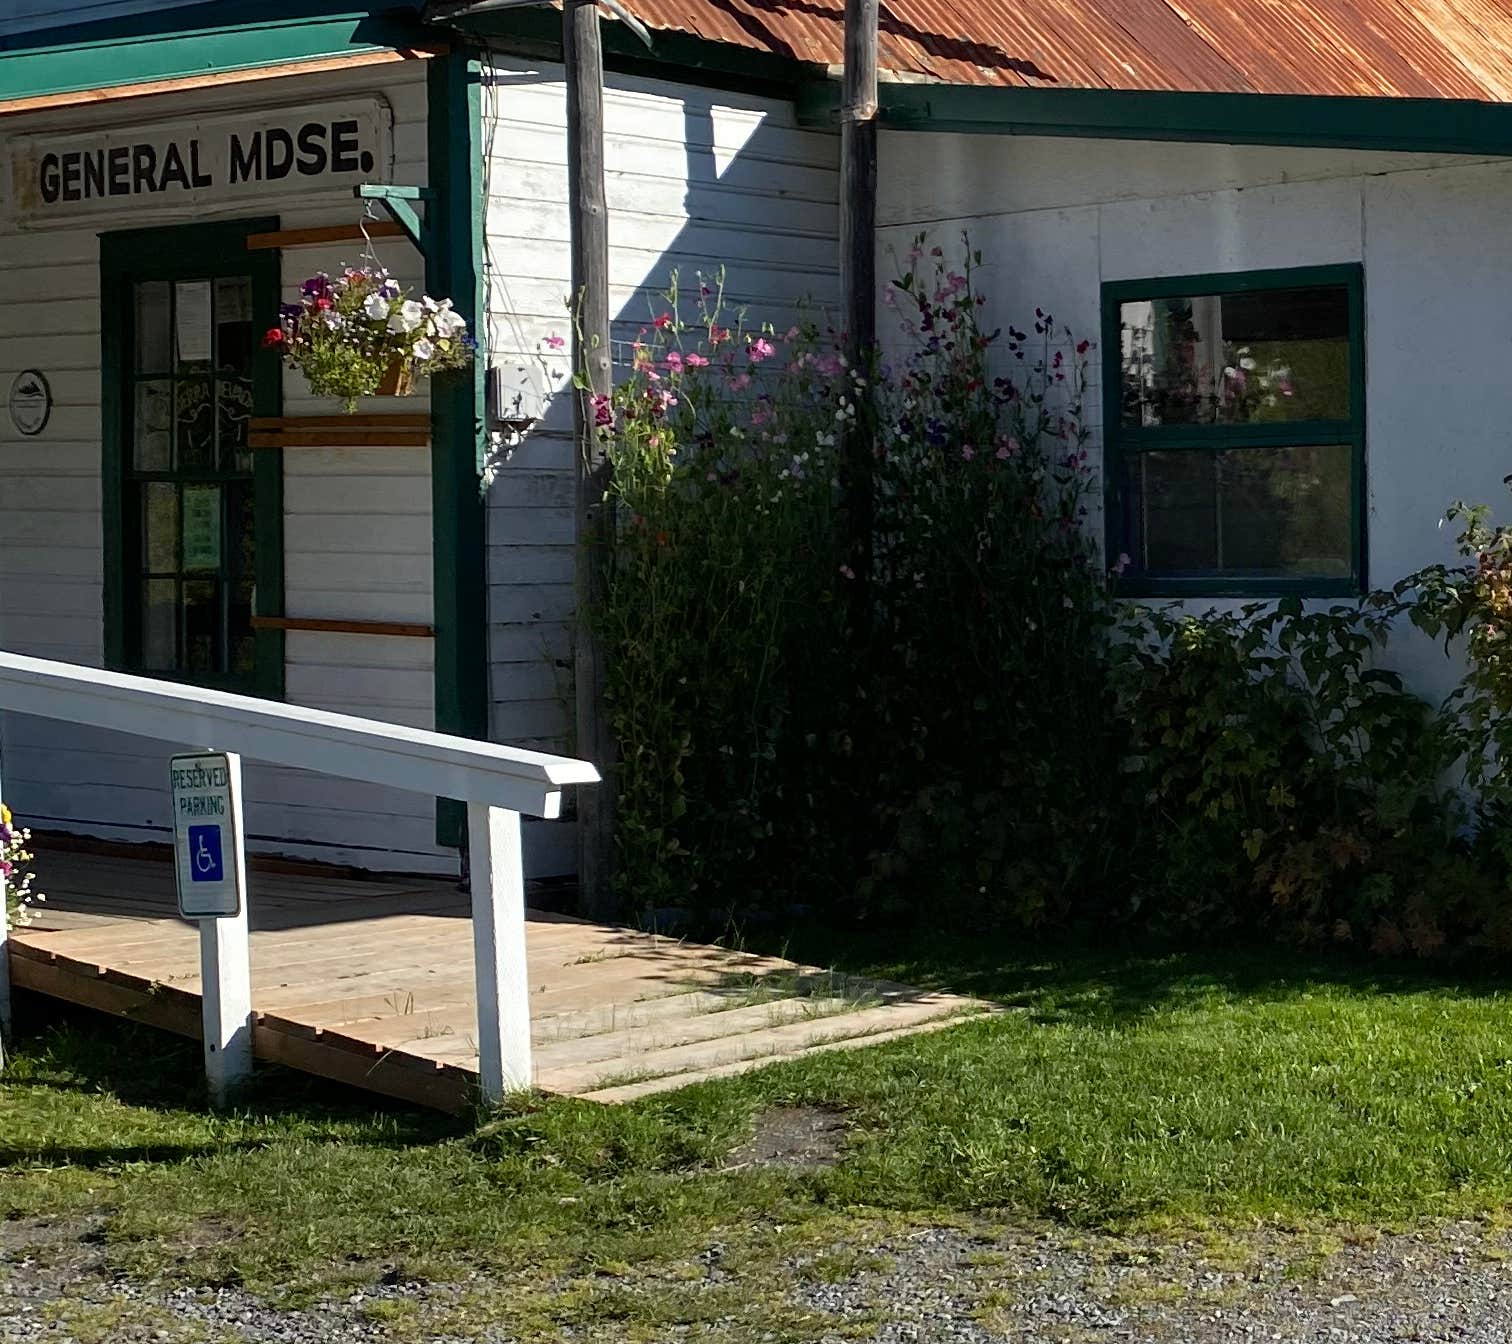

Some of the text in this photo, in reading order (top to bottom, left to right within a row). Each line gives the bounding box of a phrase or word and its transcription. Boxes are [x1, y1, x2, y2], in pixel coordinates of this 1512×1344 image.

[39, 119, 374, 204] GENERAL MDSE.
[172, 767, 228, 789] RESERVED
[179, 795, 225, 817] PARKING
